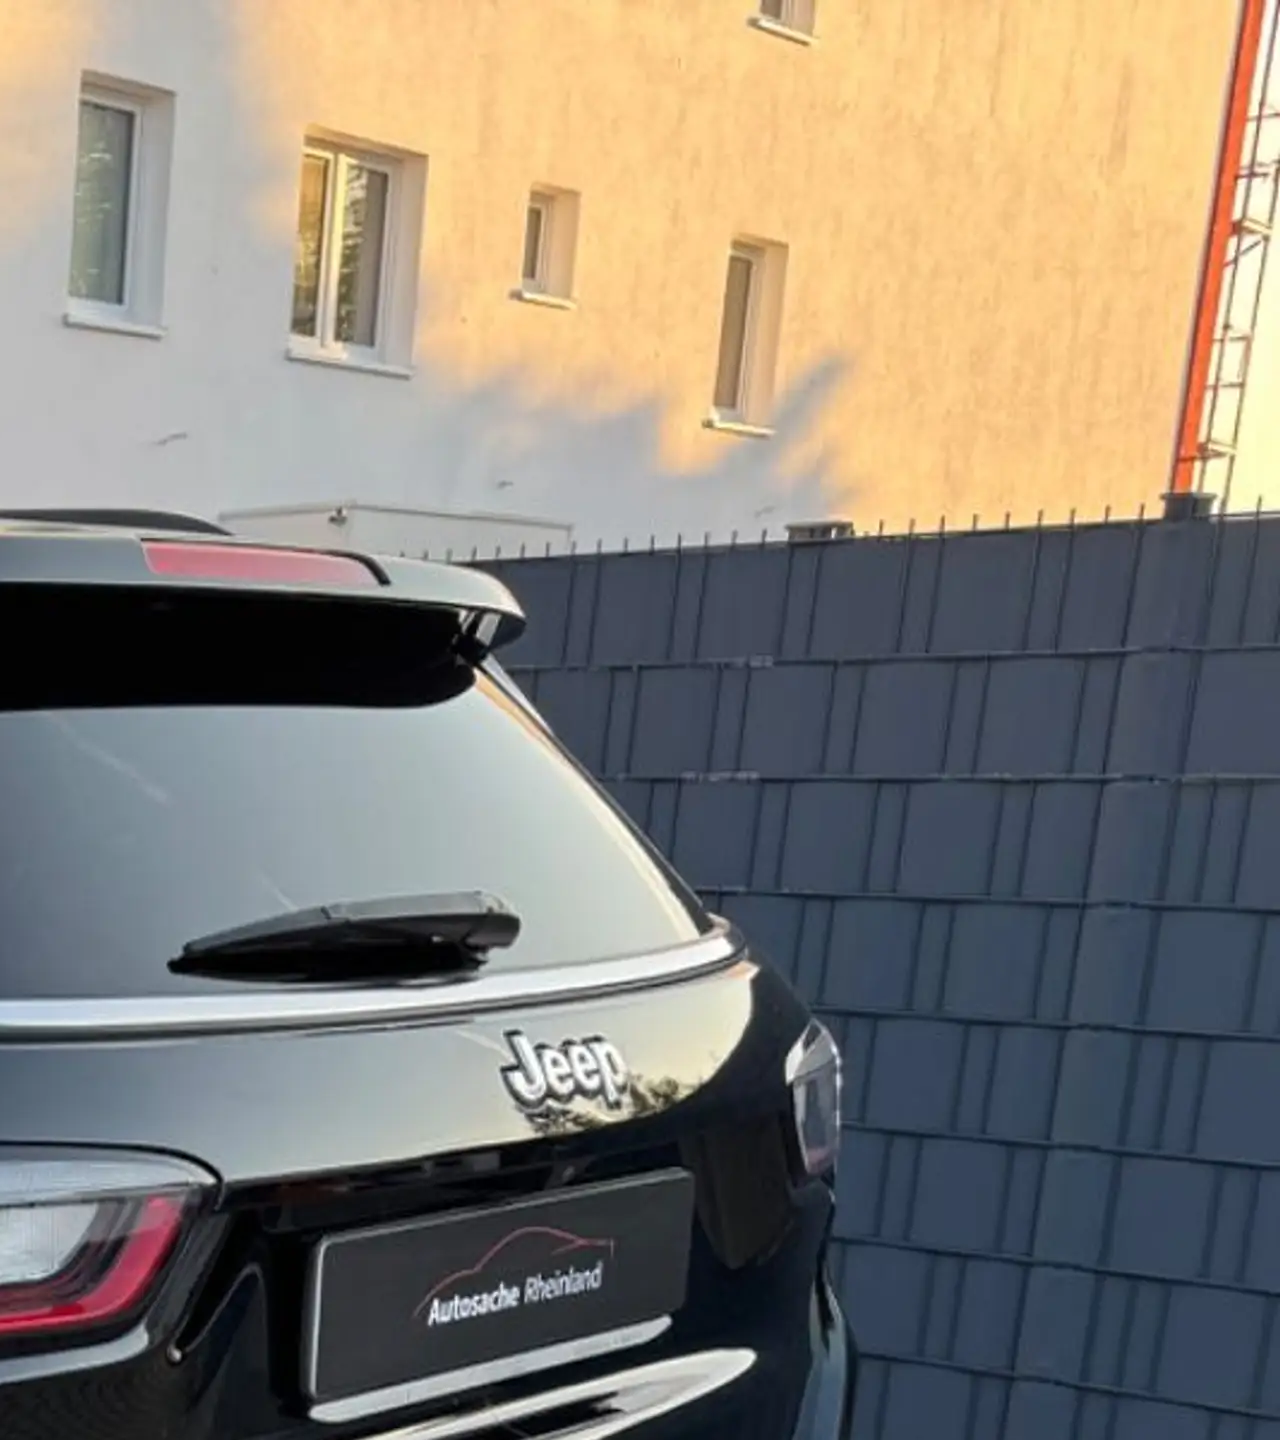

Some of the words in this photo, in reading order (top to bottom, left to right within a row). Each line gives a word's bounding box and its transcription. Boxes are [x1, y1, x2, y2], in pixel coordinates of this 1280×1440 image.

[500, 1029, 627, 1110] Jeep
[428, 1282, 519, 1326] Autosache
[524, 1260, 602, 1303] Rheinland
